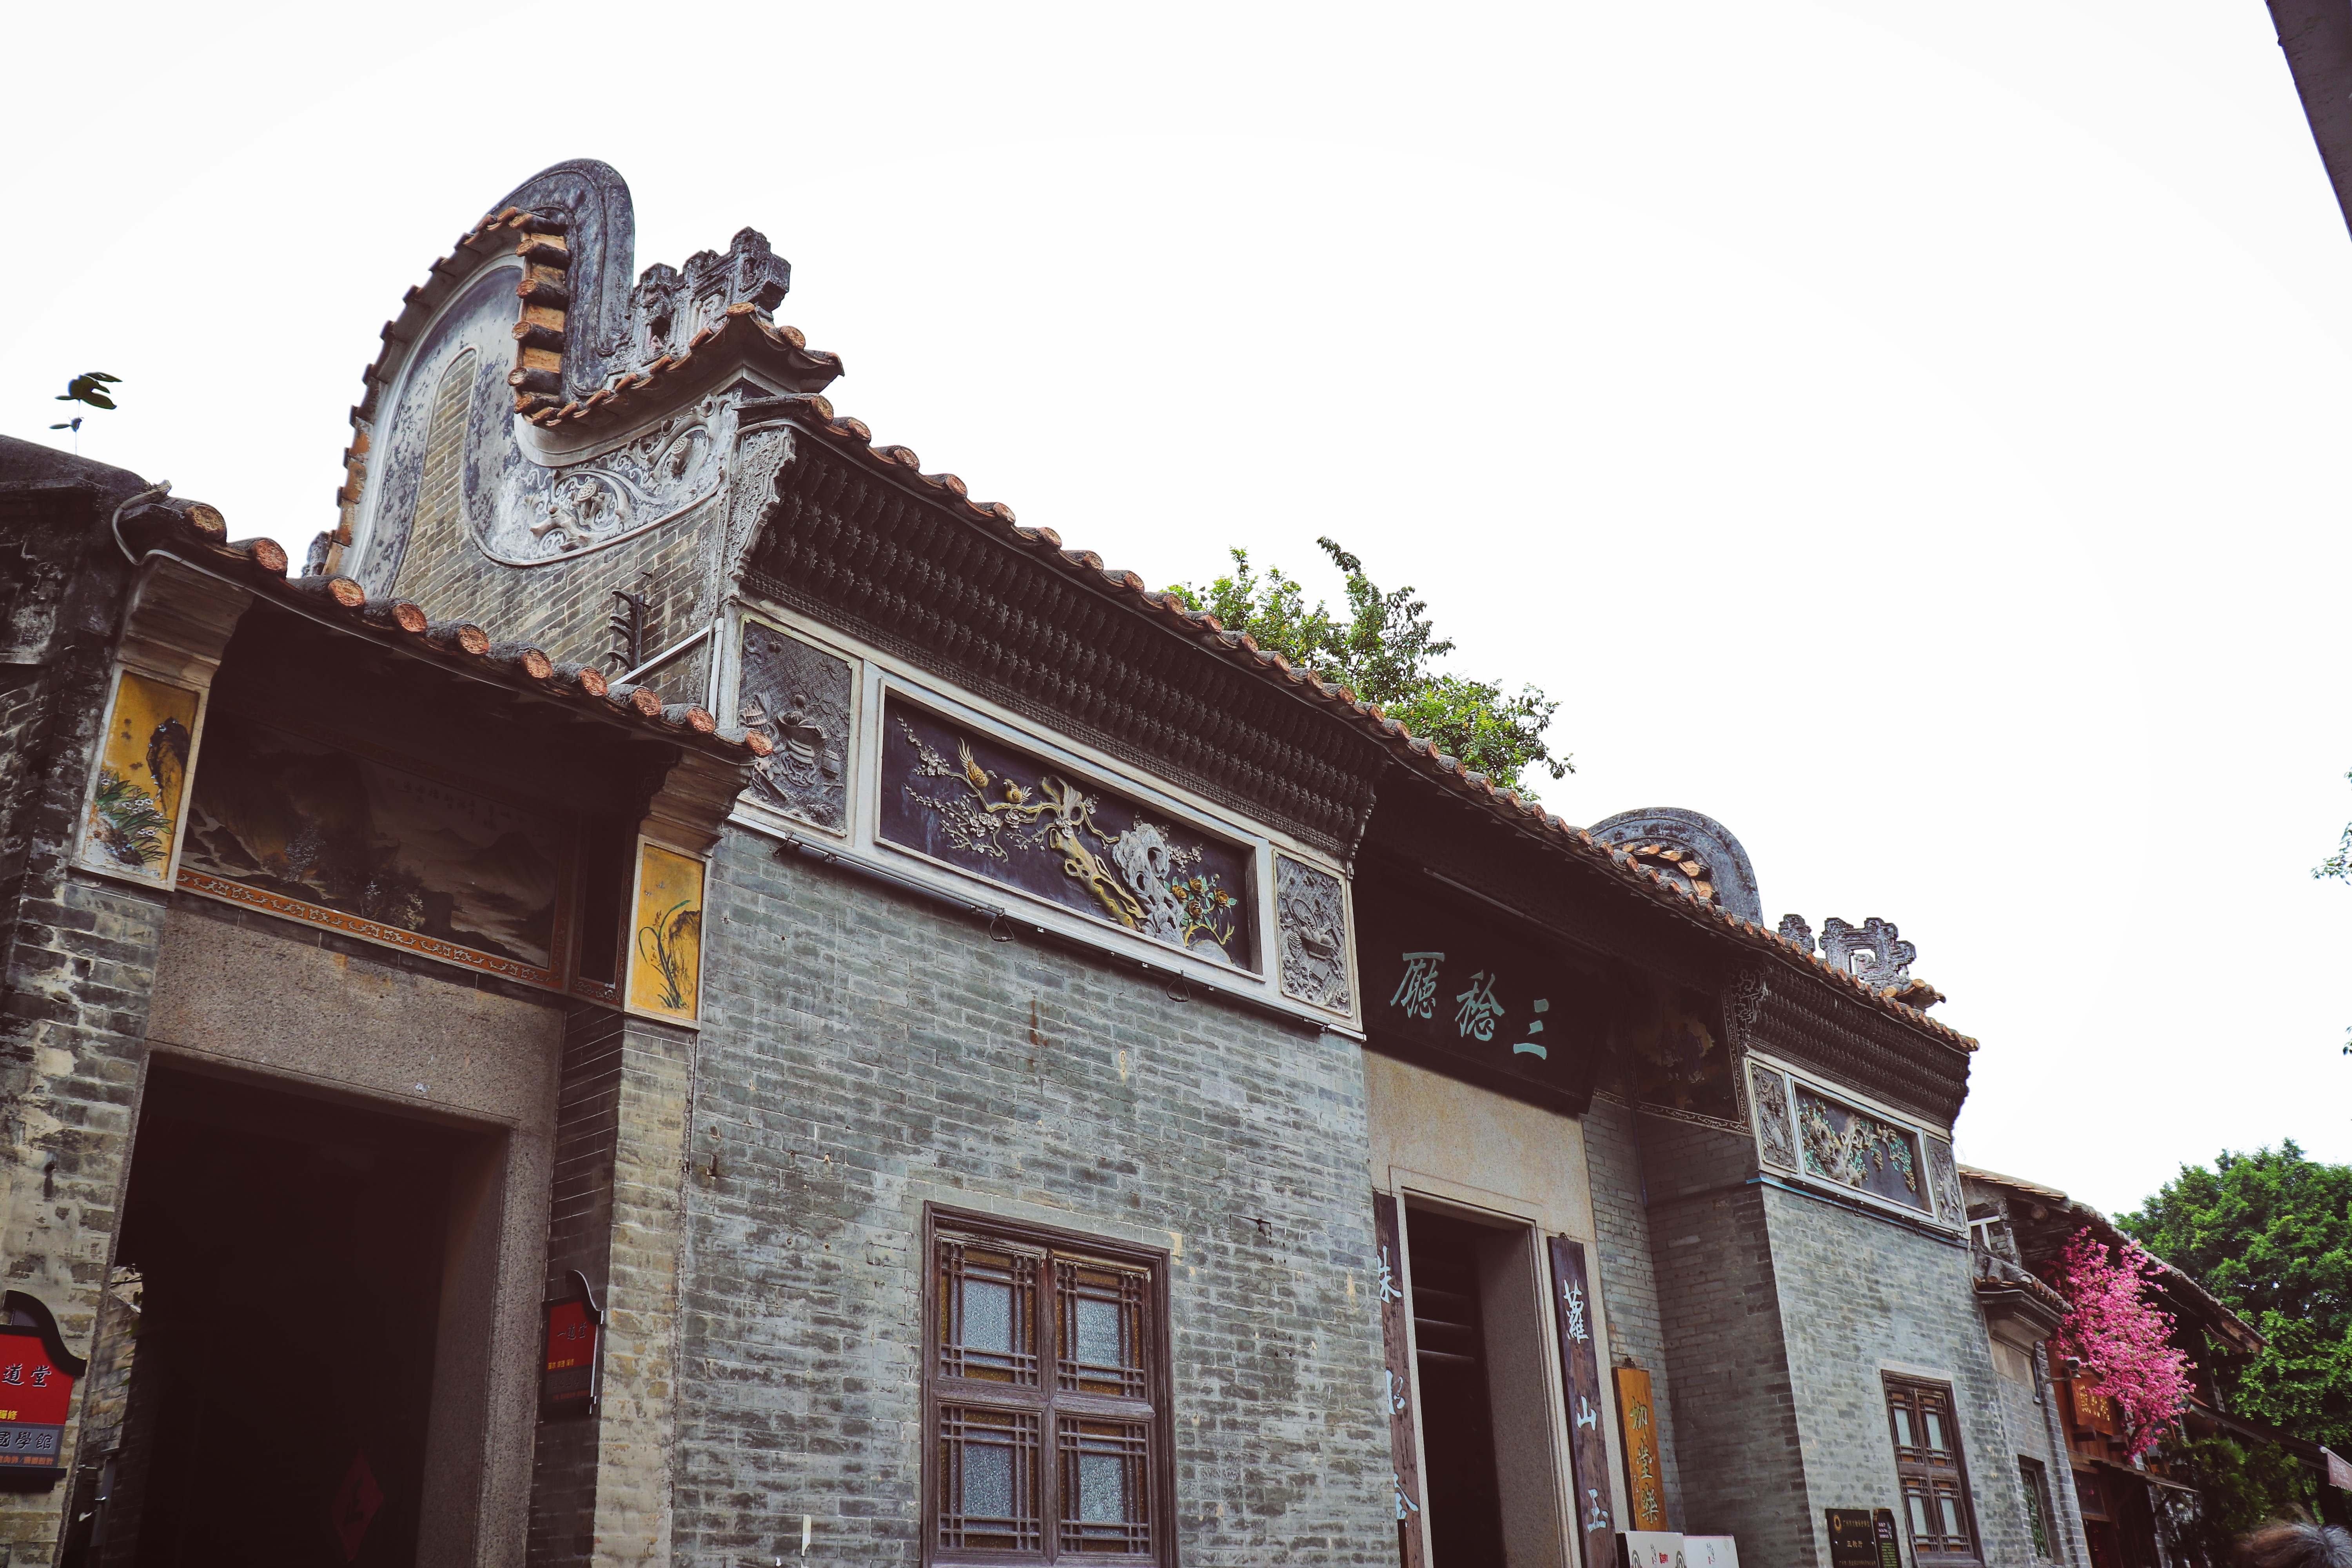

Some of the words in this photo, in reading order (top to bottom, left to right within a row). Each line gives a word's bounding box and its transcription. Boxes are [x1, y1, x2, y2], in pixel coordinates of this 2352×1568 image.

[557, 1321, 588, 1340] 一道堂
[2, 1363, 52, 1388] 道堂
